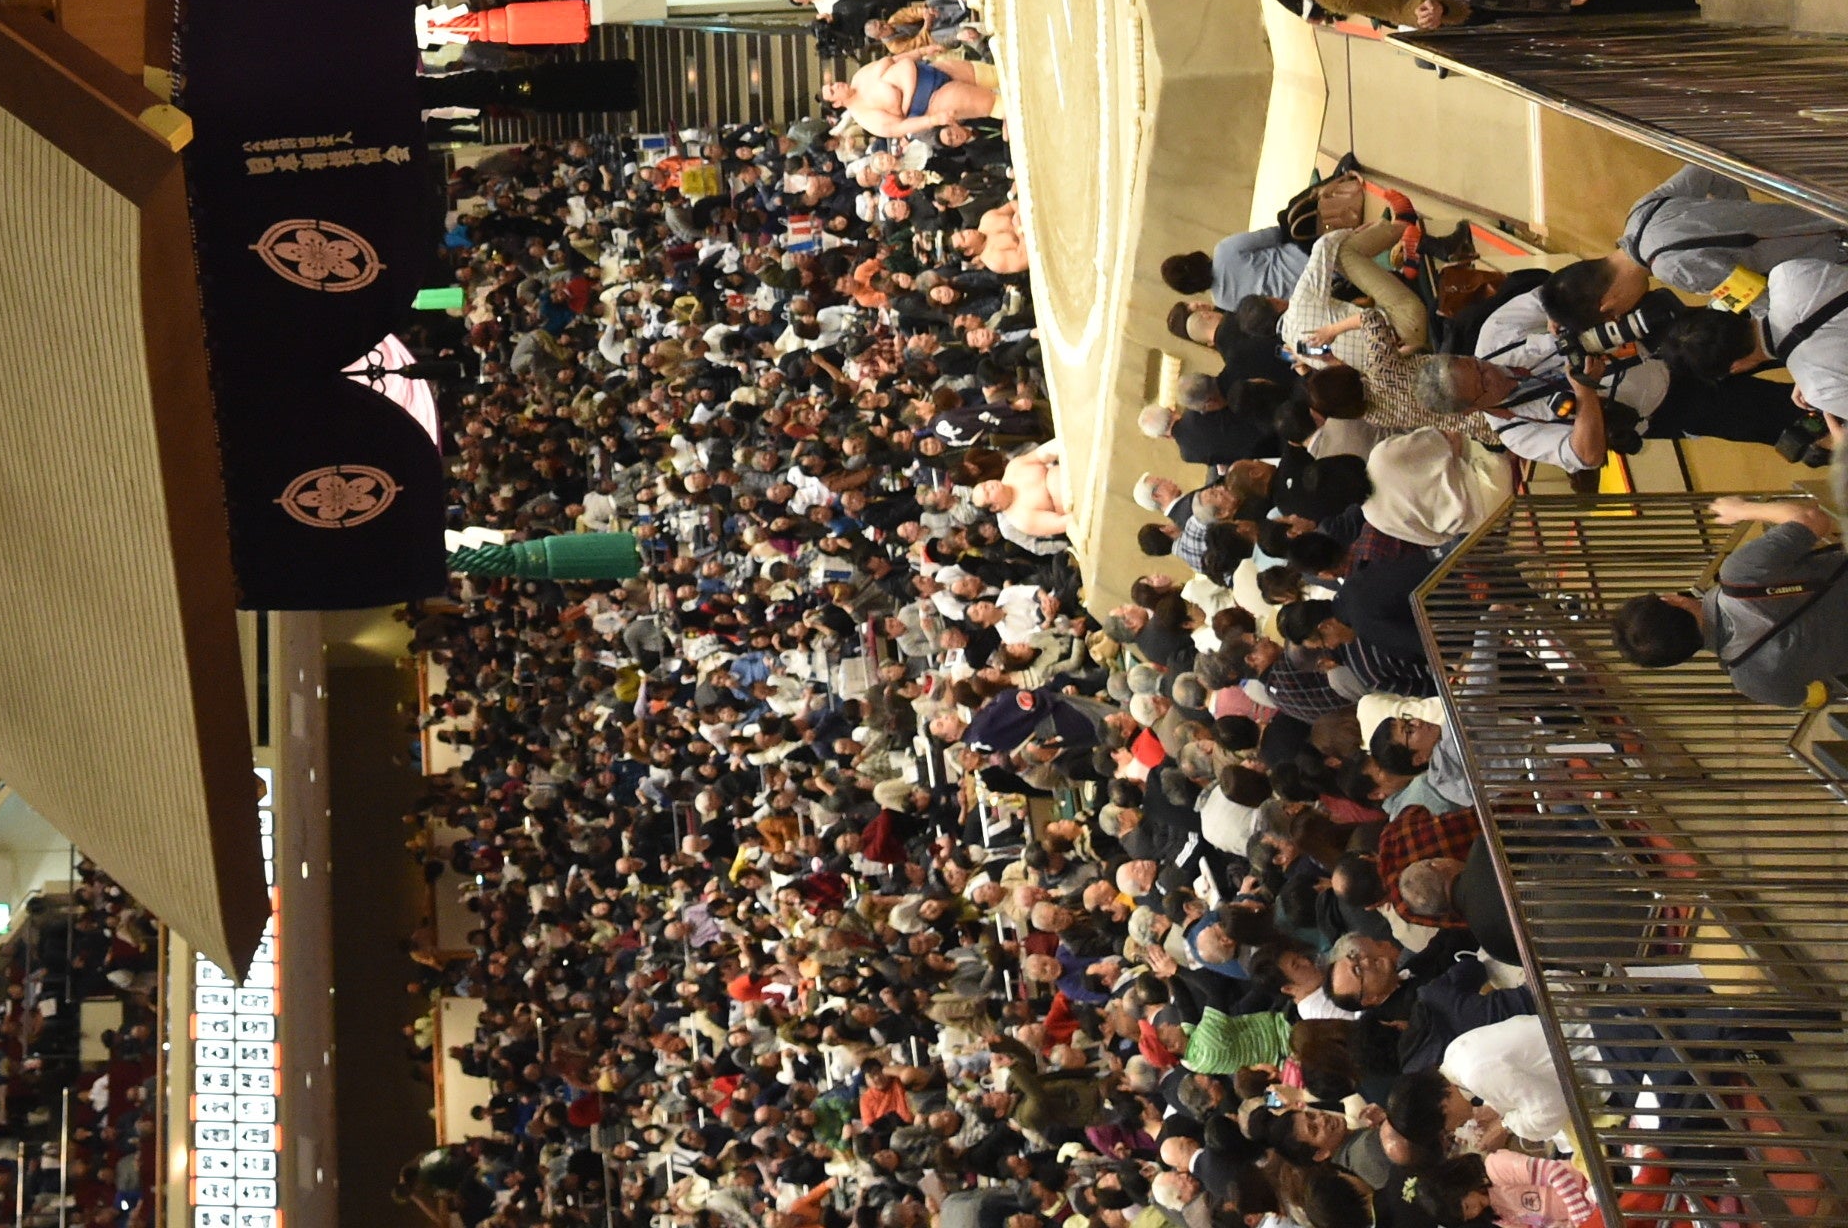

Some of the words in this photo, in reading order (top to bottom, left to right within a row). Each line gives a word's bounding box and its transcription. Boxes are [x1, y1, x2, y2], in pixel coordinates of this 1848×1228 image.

[245, 145, 410, 175] 日本相撲協会
